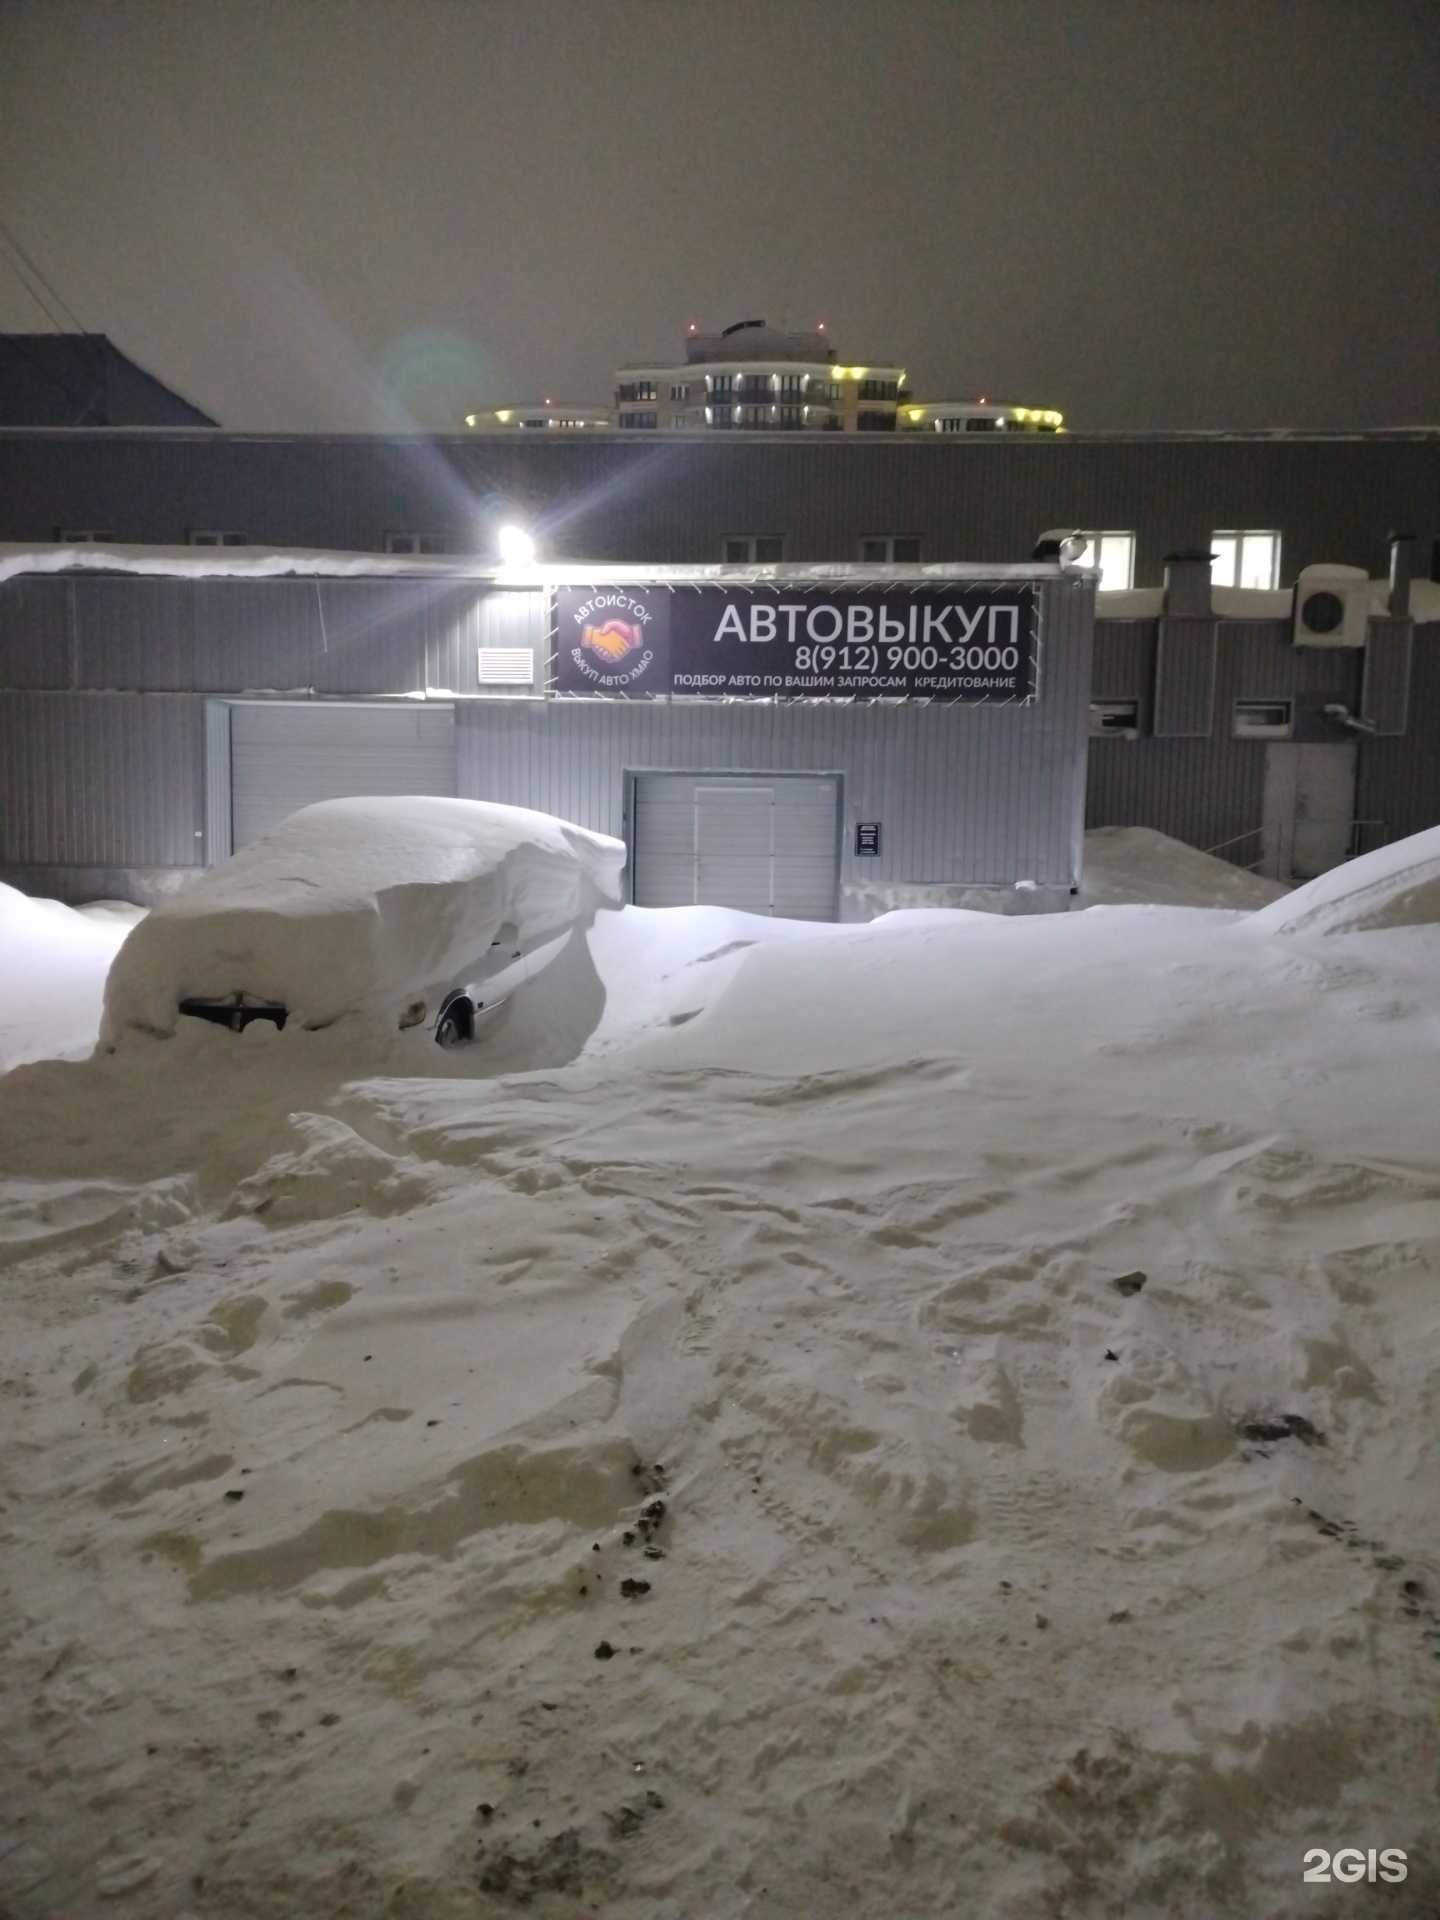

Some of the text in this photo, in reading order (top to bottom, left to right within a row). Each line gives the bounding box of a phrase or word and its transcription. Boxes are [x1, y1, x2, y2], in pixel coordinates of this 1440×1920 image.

[573, 594, 653, 625] АВТОИСТОК
[713, 604, 1019, 643] АВТОВЫКУП
[571, 647, 654, 686] ВЫКУП АВТО ХМАО
[795, 645, 1019, 674] 8(912) 900-3000
[674, 674, 907, 687] ПОДБОР АВТО ПО ВАШИМ ЗАПРОСАМ
[914, 677, 1016, 689] КРЕДИТОВАНИЕ
